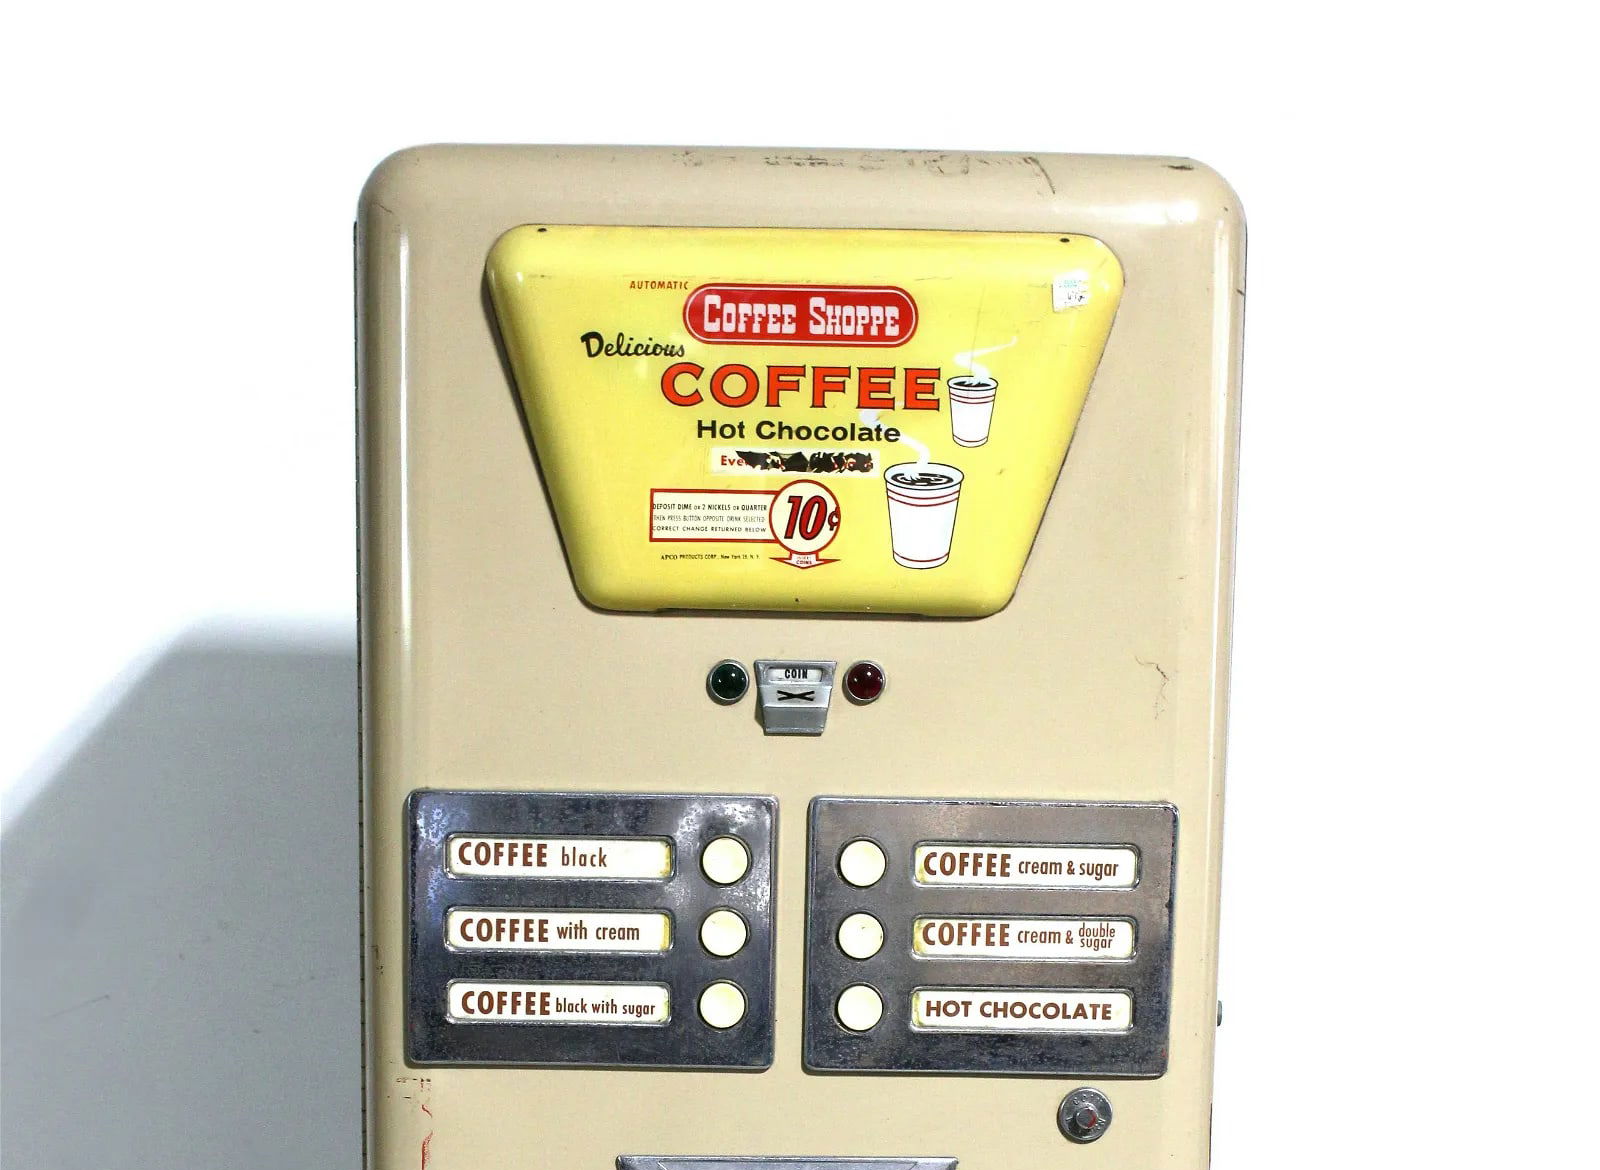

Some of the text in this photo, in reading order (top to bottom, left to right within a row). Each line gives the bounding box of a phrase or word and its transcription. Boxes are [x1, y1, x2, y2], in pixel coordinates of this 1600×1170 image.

[629, 280, 689, 290] AUTOMATIC
[703, 294, 900, 336] COFFEE SHOPPE
[580, 331, 685, 358] Delicious
[660, 362, 941, 411] COFFEE
[697, 419, 901, 443] Hot Chocolate
[707, 503, 731, 511] NICKELS
[743, 515, 765, 523] SELECTED
[784, 668, 808, 680] COIN
[458, 841, 608, 868] COFFEE black
[923, 851, 1119, 881] COFFEE cream & sugar
[460, 918, 640, 942] COFFEE with cream
[922, 922, 1116, 947] COFFEE cream & double
[1080, 937, 1113, 951] sugar
[461, 990, 656, 1018] COFFEE black with sugar
[925, 1000, 1112, 1020] HOT CHOCOLATE
